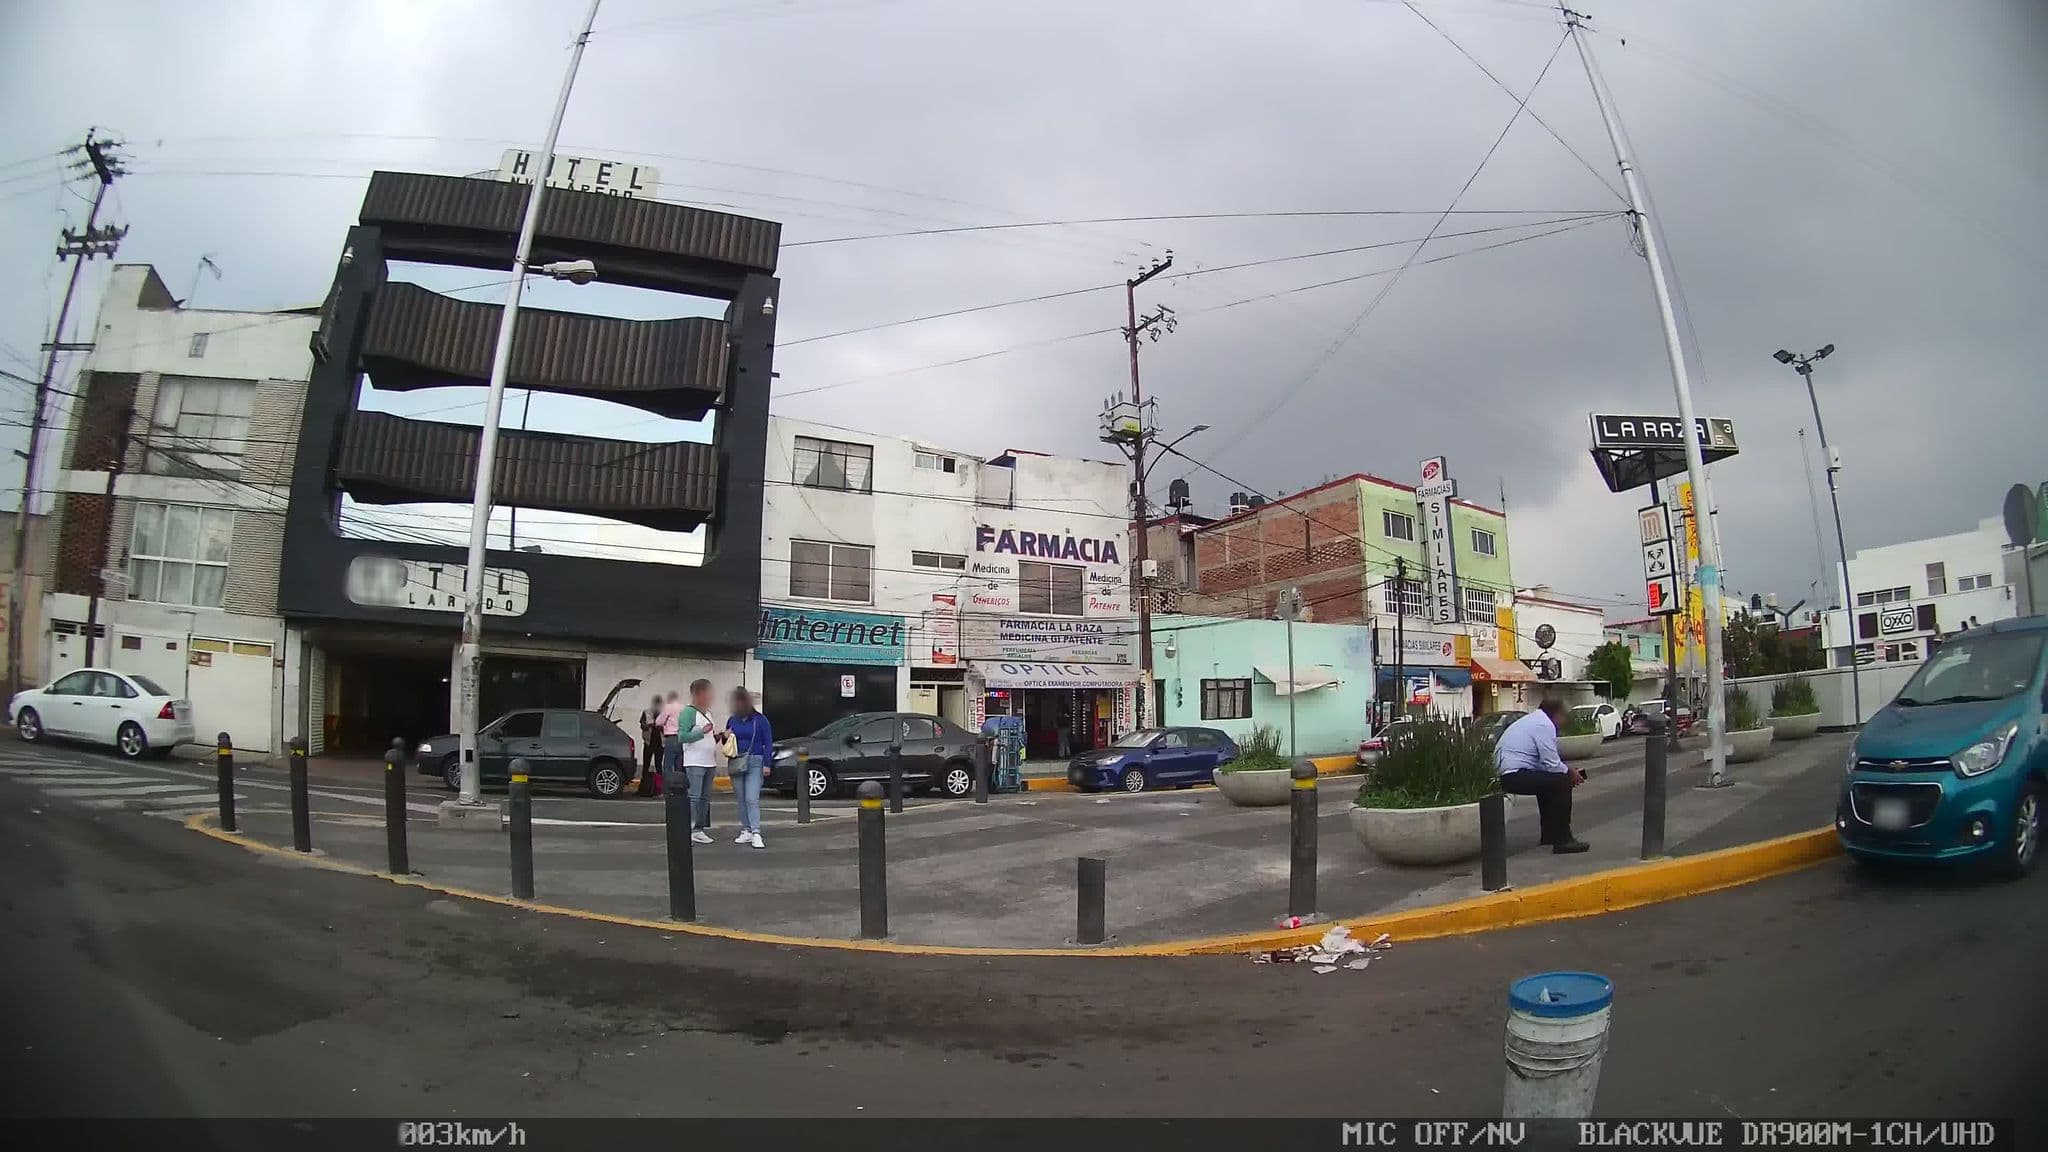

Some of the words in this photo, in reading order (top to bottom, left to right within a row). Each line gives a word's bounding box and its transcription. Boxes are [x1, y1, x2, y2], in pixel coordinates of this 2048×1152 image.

[1602, 421, 1636, 437] LA
[1642, 422, 1706, 439] RAZA
[1722, 423, 1732, 433] 3
[1714, 434, 1724, 445] 5
[1417, 484, 1451, 499] FARMACIAS
[976, 526, 1120, 565] FARMACIA
[972, 562, 1010, 575] Medicina
[1431, 502, 1449, 621] SIMILARES
[1089, 571, 1122, 584] Medicina
[987, 580, 999, 591] de
[1101, 586, 1112, 597] de
[408, 592, 513, 612] LARDO
[1088, 597, 1121, 611] PATENTE
[999, 619, 1056, 632] FARMACIA
[1059, 621, 1073, 632] LA
[1075, 622, 1103, 634] RAZA
[1883, 613, 1912, 629] OXXO
[758, 610, 903, 647] Internet
[999, 632, 1048, 644] MEDICINA
[1063, 634, 1104, 645] PATENTE
[999, 663, 1099, 677] OPTICA
[1023, 680, 1047, 688] OPTICA
